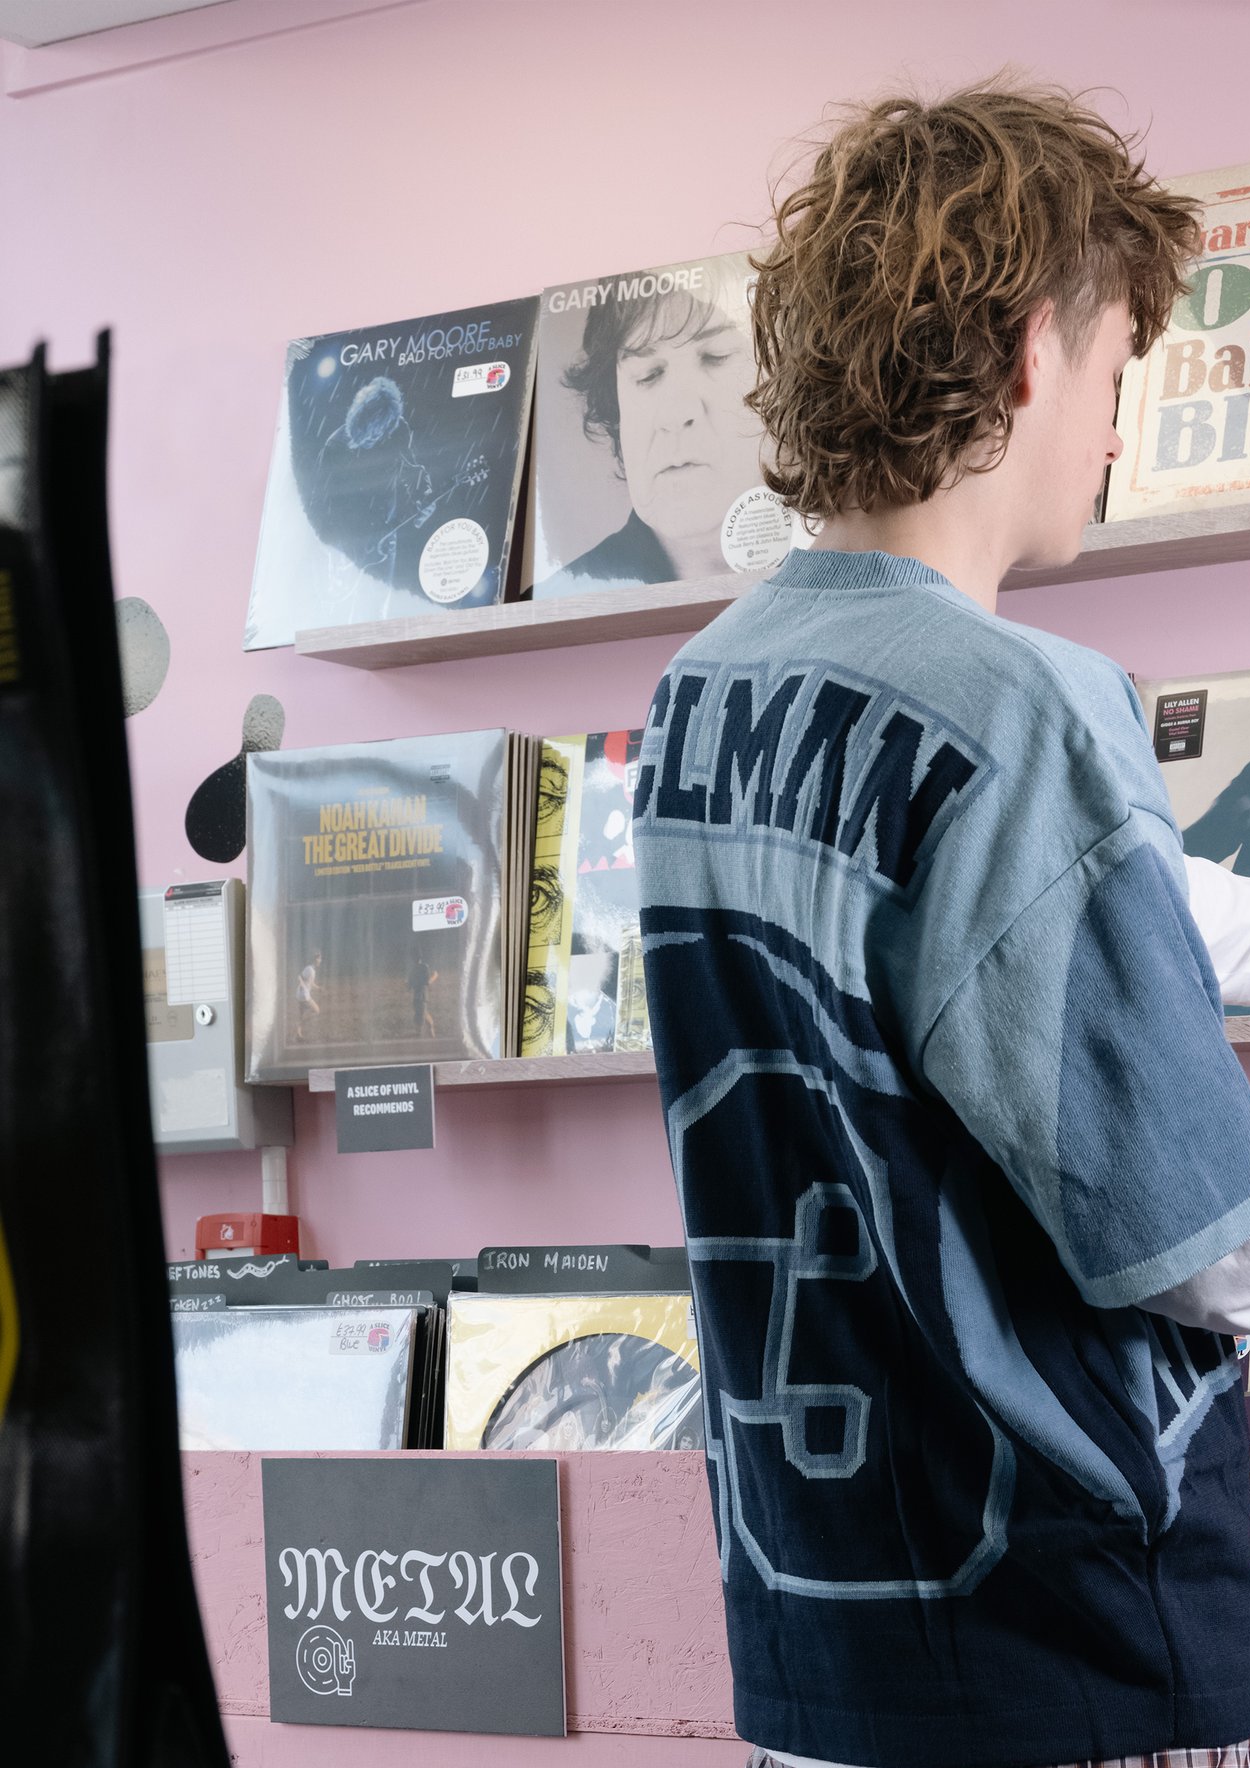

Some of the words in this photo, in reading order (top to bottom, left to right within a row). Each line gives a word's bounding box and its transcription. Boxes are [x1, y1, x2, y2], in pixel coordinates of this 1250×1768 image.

[548, 282, 613, 314] GARY
[617, 266, 705, 303] MOORE
[340, 336, 402, 367] GARY
[406, 320, 493, 356] MOORE
[398, 350, 426, 366] BAD
[427, 345, 454, 362] FOR
[457, 338, 486, 355] YOU
[487, 332, 523, 351] BABY
[726, 502, 747, 538] CLOSE
[748, 493, 761, 504] AS
[1163, 708, 1175, 716] NO
[1175, 705, 1200, 714] SHAME
[1164, 701, 1178, 709] LILY
[1178, 698, 1200, 707] ALLEN
[320, 800, 367, 833] NOAH
[303, 834, 334, 865] THE
[334, 828, 388, 862] GREAT
[389, 823, 444, 857] DIVIDE
[347, 1087, 355, 1099] A
[354, 1085, 380, 1099] SLICE
[379, 1084, 392, 1097] OF
[391, 1082, 419, 1096] VINYL
[353, 1100, 414, 1117] RECOMMENDS
[167, 1264, 222, 1282] EFTONES
[483, 1250, 531, 1272] IRON
[543, 1251, 609, 1274] MAIDEN
[372, 1630, 401, 1647] AKA
[402, 1630, 448, 1648] METAL
